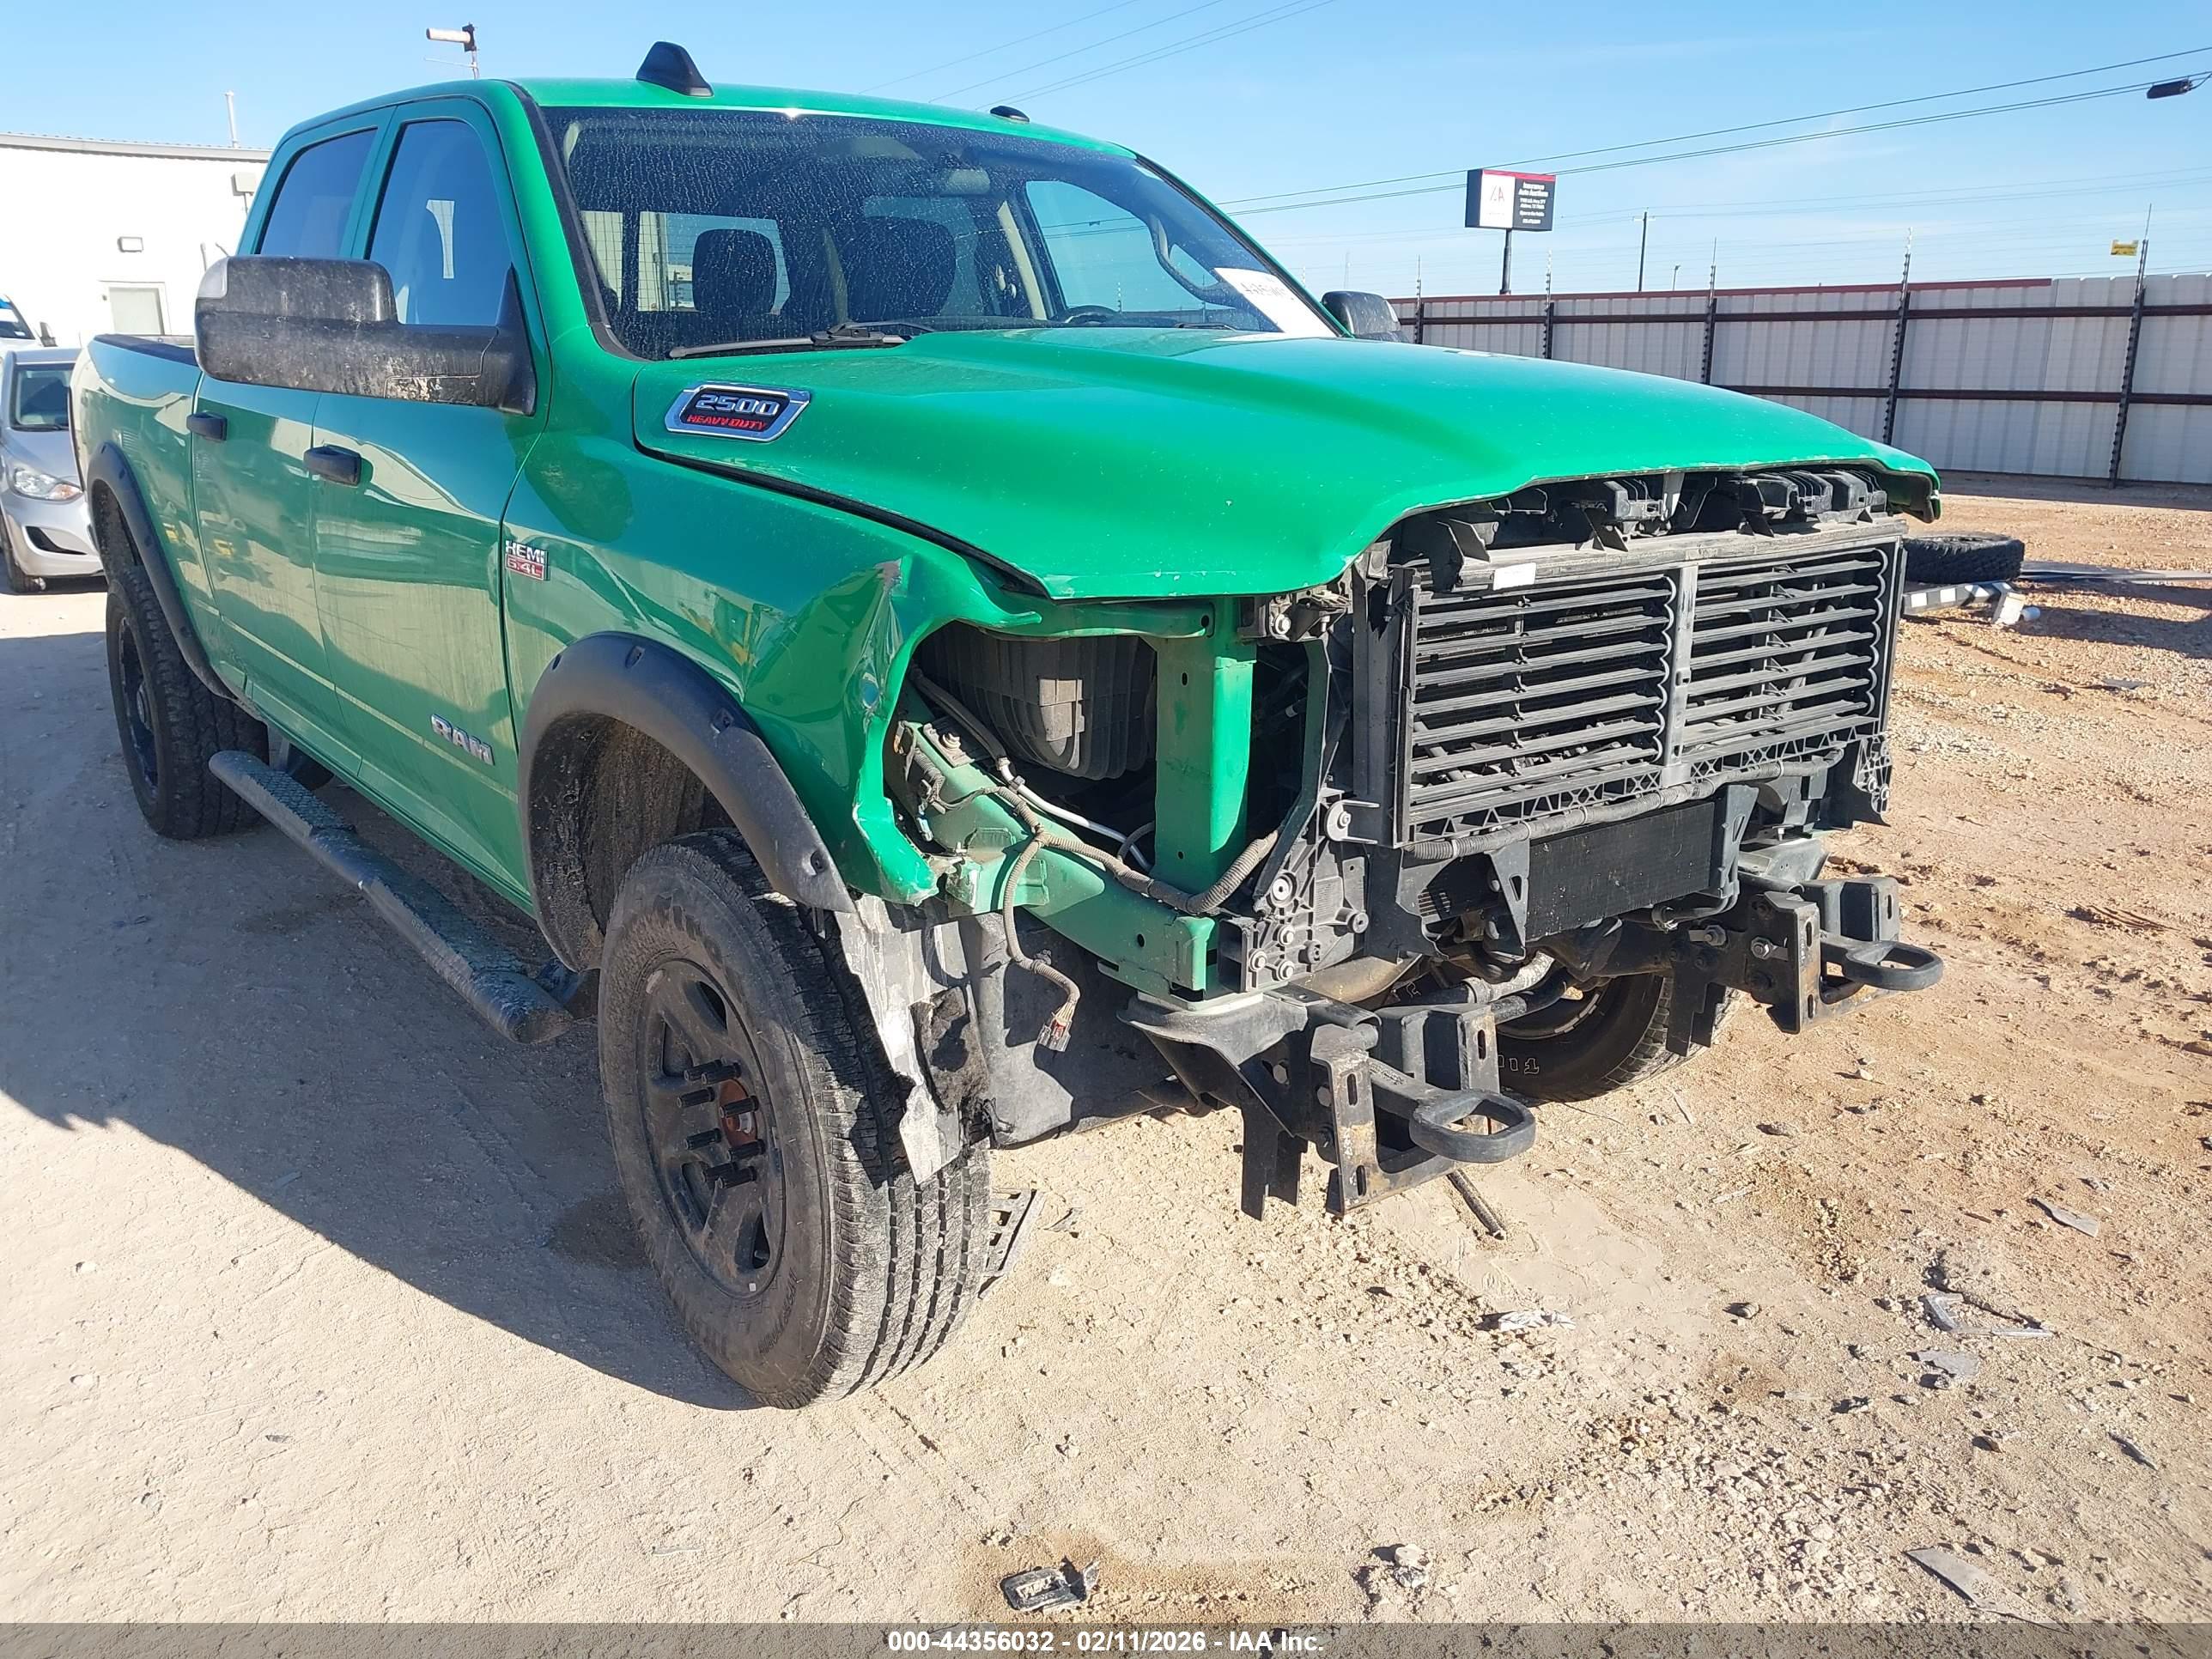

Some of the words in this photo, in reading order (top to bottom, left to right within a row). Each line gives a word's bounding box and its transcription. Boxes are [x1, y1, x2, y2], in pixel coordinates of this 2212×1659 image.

[695, 394, 781, 416] 2500
[687, 415, 728, 426] HEAVY
[728, 418, 768, 430] DUTY
[505, 539, 545, 564] HEMI
[507, 556, 542, 578] 6.4L
[431, 714, 495, 766] RAM
